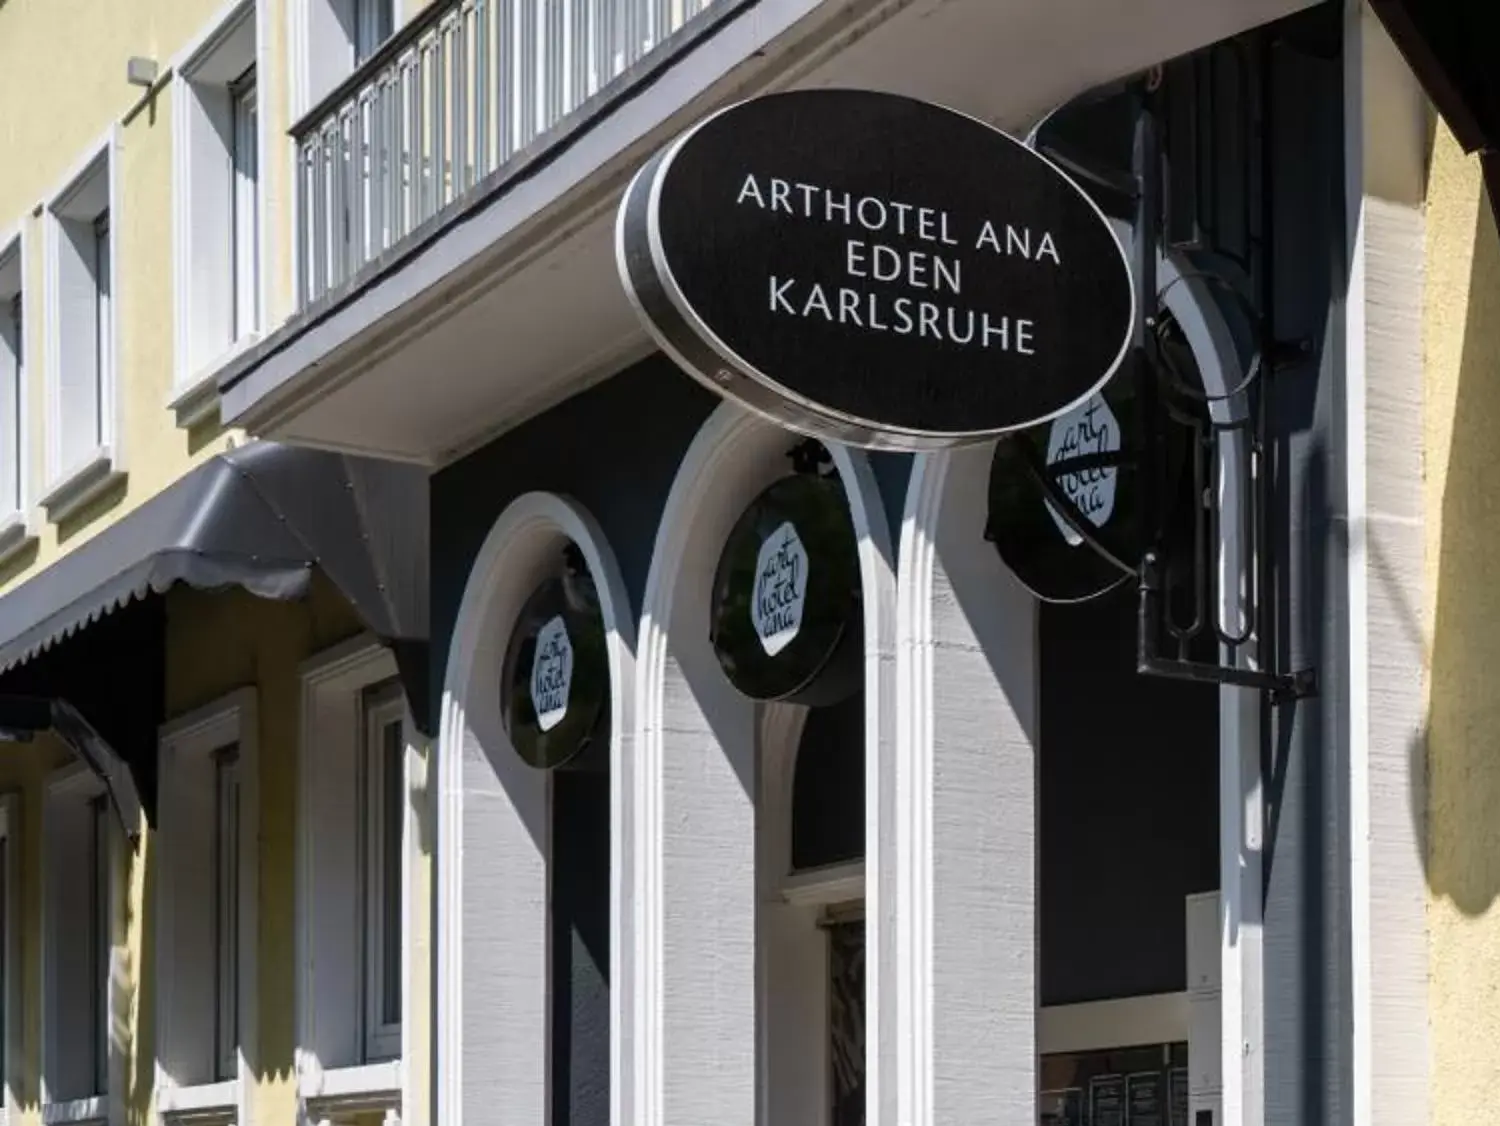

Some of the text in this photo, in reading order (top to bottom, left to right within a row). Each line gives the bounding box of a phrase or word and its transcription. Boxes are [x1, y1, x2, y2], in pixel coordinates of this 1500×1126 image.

[737, 173, 1062, 264] ARTHOTEL ANA
[846, 240, 962, 294] EDEN
[768, 276, 1036, 355] KARLSRUHE
[758, 553, 800, 621] hotel
[763, 606, 795, 639] ana
